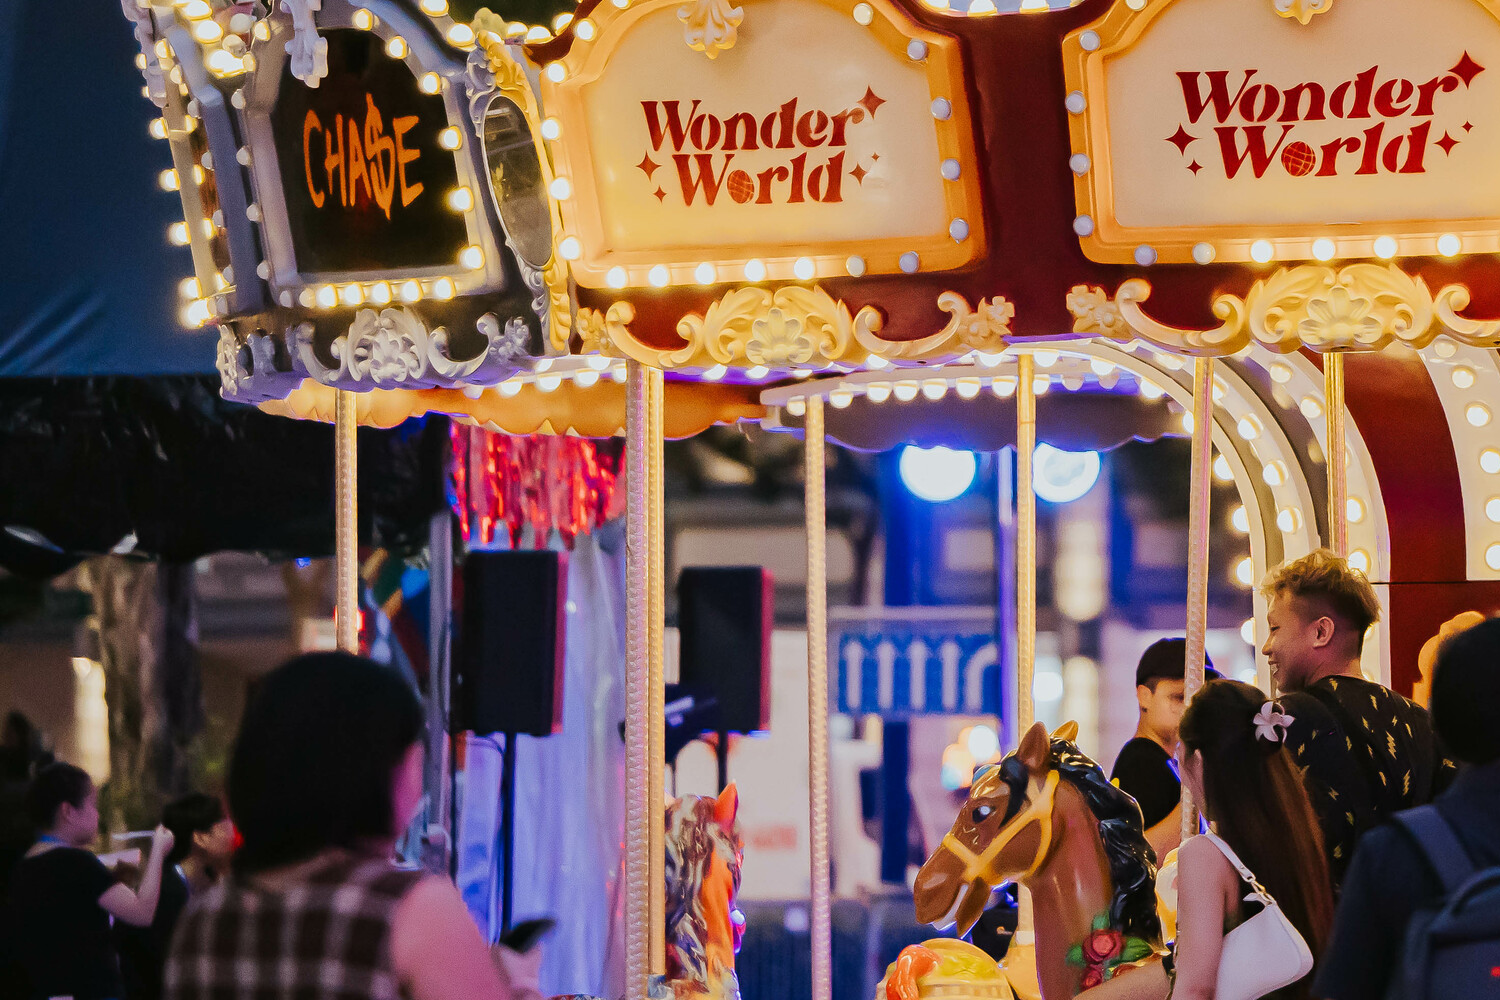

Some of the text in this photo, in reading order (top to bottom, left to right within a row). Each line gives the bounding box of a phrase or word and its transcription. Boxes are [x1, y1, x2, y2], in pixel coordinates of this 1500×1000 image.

[1175, 65, 1459, 124] Wonder
[640, 96, 865, 152] Wonder
[1212, 119, 1432, 180] World
[671, 149, 846, 207] World
